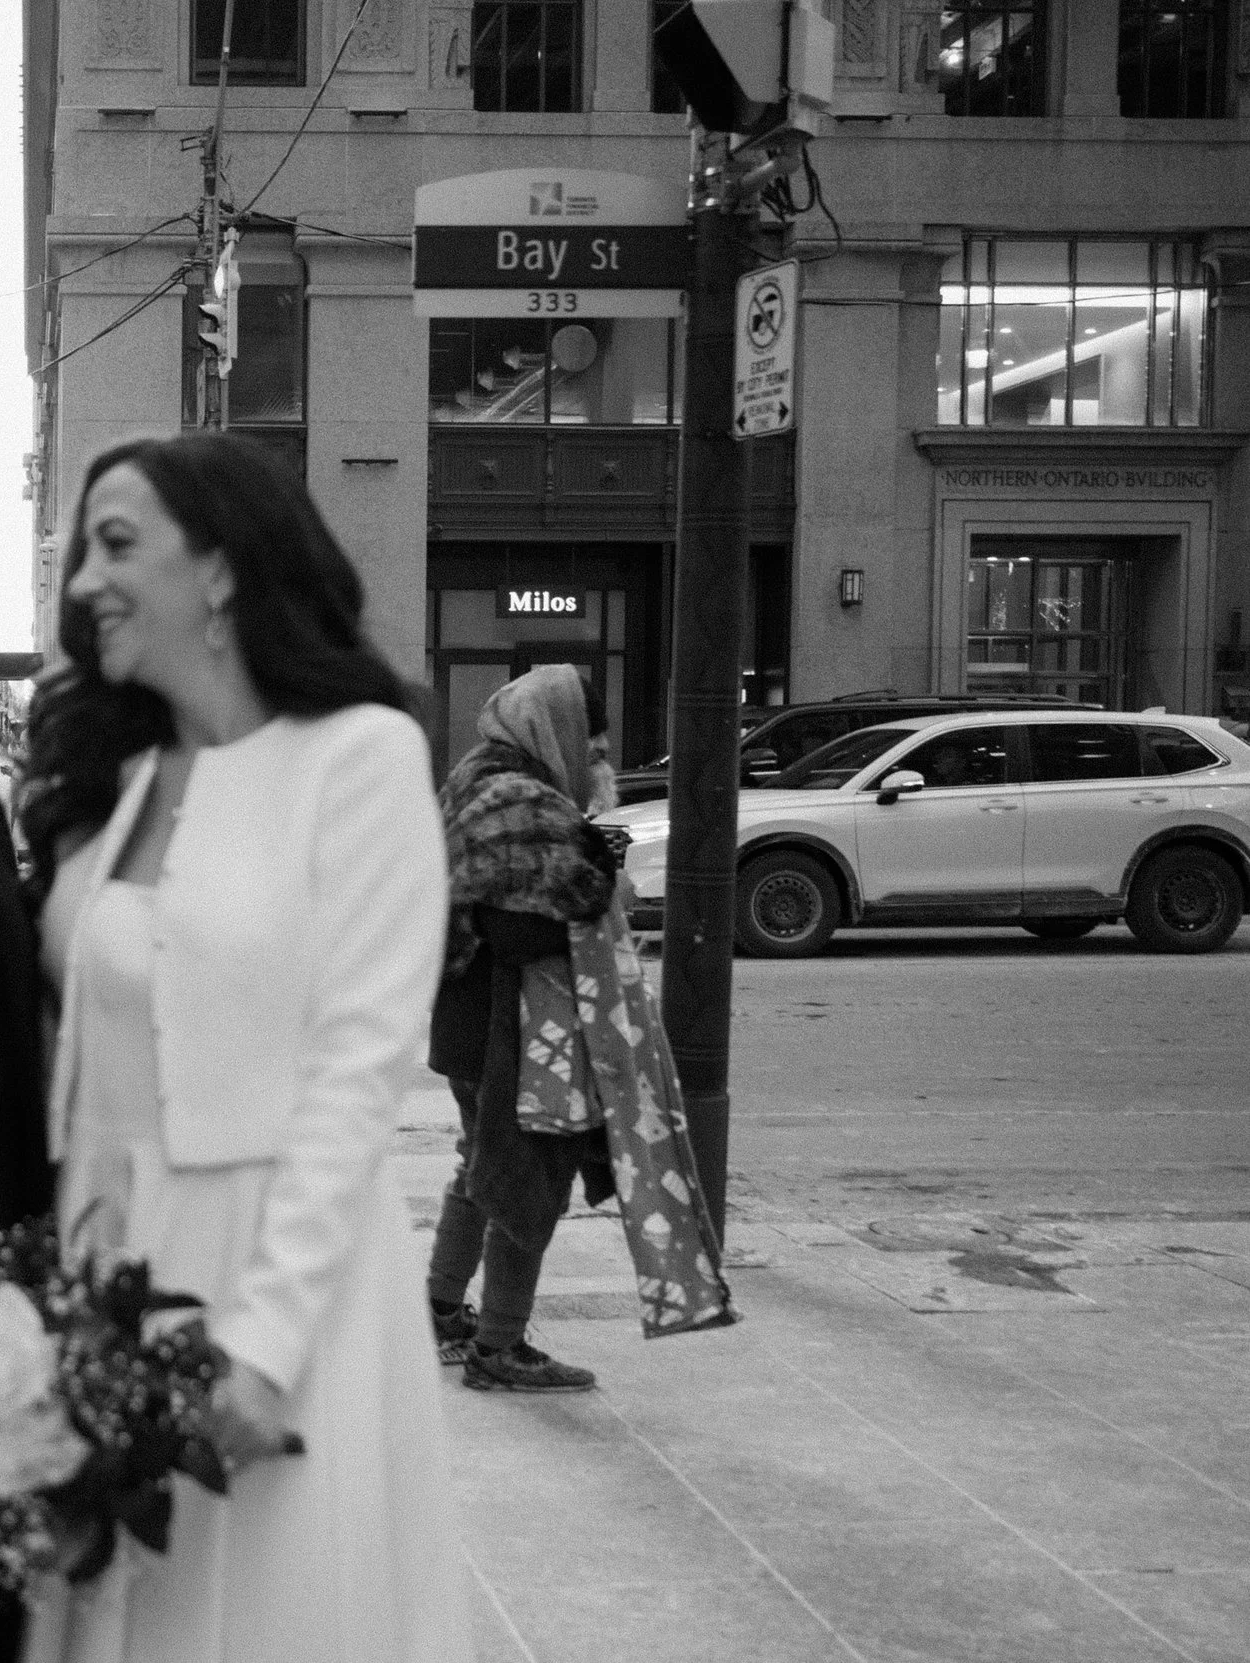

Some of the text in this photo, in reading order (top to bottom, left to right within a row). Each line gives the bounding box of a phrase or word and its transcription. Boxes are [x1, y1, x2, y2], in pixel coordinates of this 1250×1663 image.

[497, 231, 619, 279] Bay St
[528, 292, 577, 312] 333
[945, 470, 1207, 488] NORTHERN ONTARIO BVILDING
[508, 591, 577, 612] Milos
